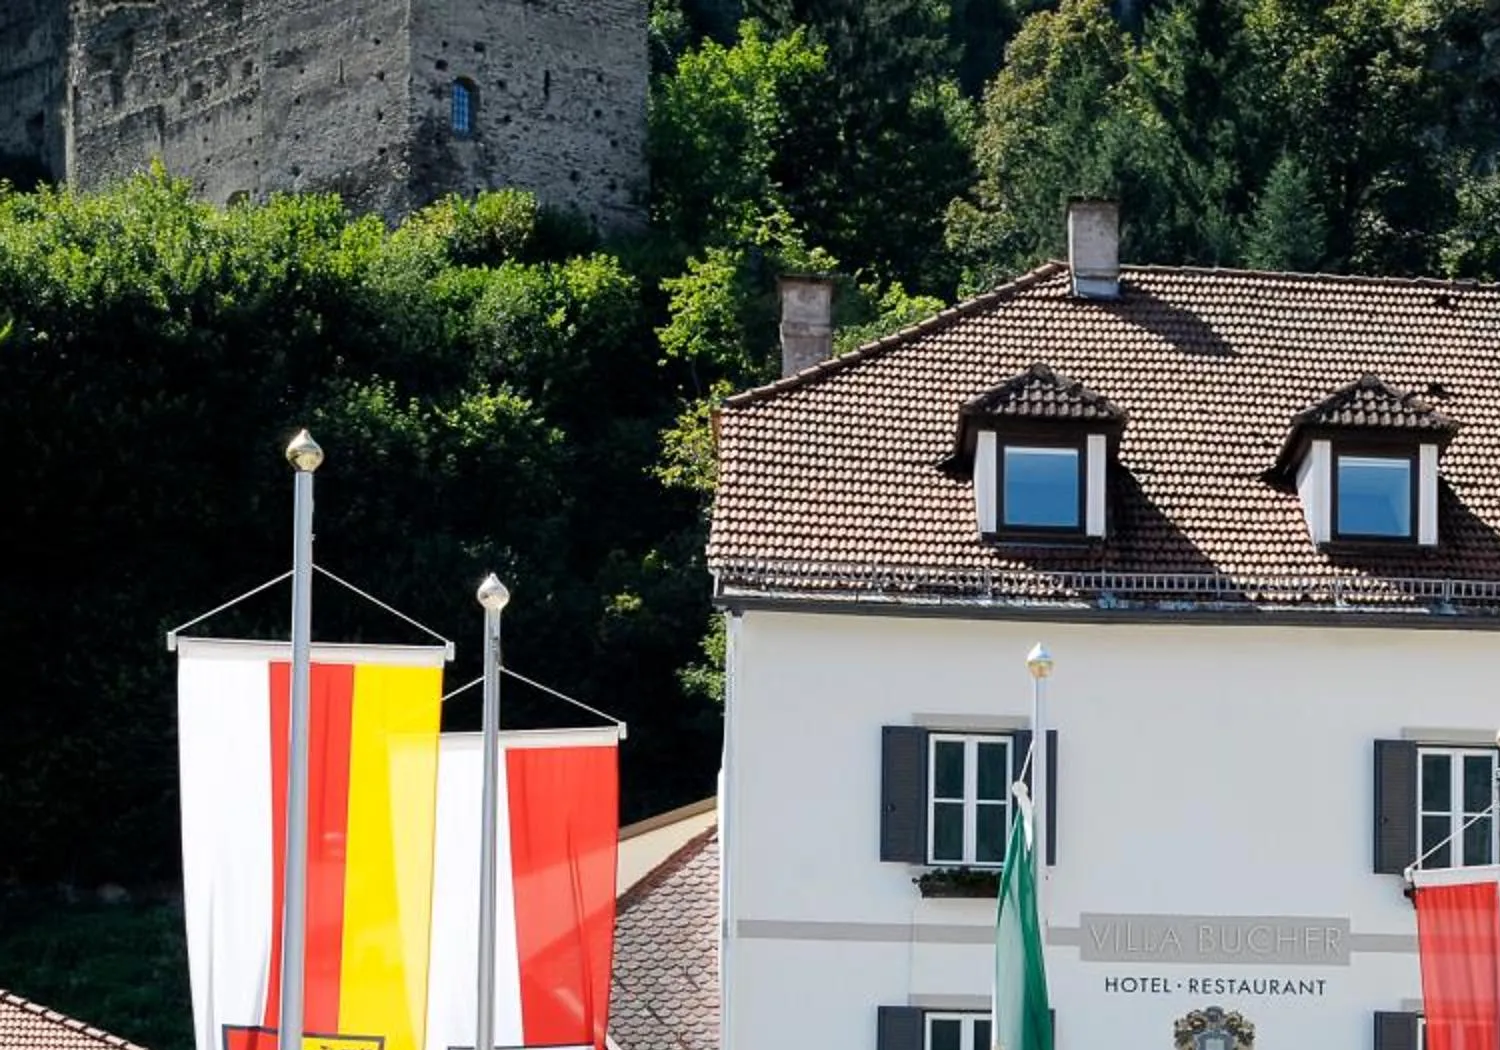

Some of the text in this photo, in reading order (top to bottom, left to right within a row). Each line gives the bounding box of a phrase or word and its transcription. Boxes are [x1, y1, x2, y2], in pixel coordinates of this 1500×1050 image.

[1089, 921, 1343, 955] VILLA BUCHER
[1104, 976, 1327, 996] HOTEL RESTAURANT
